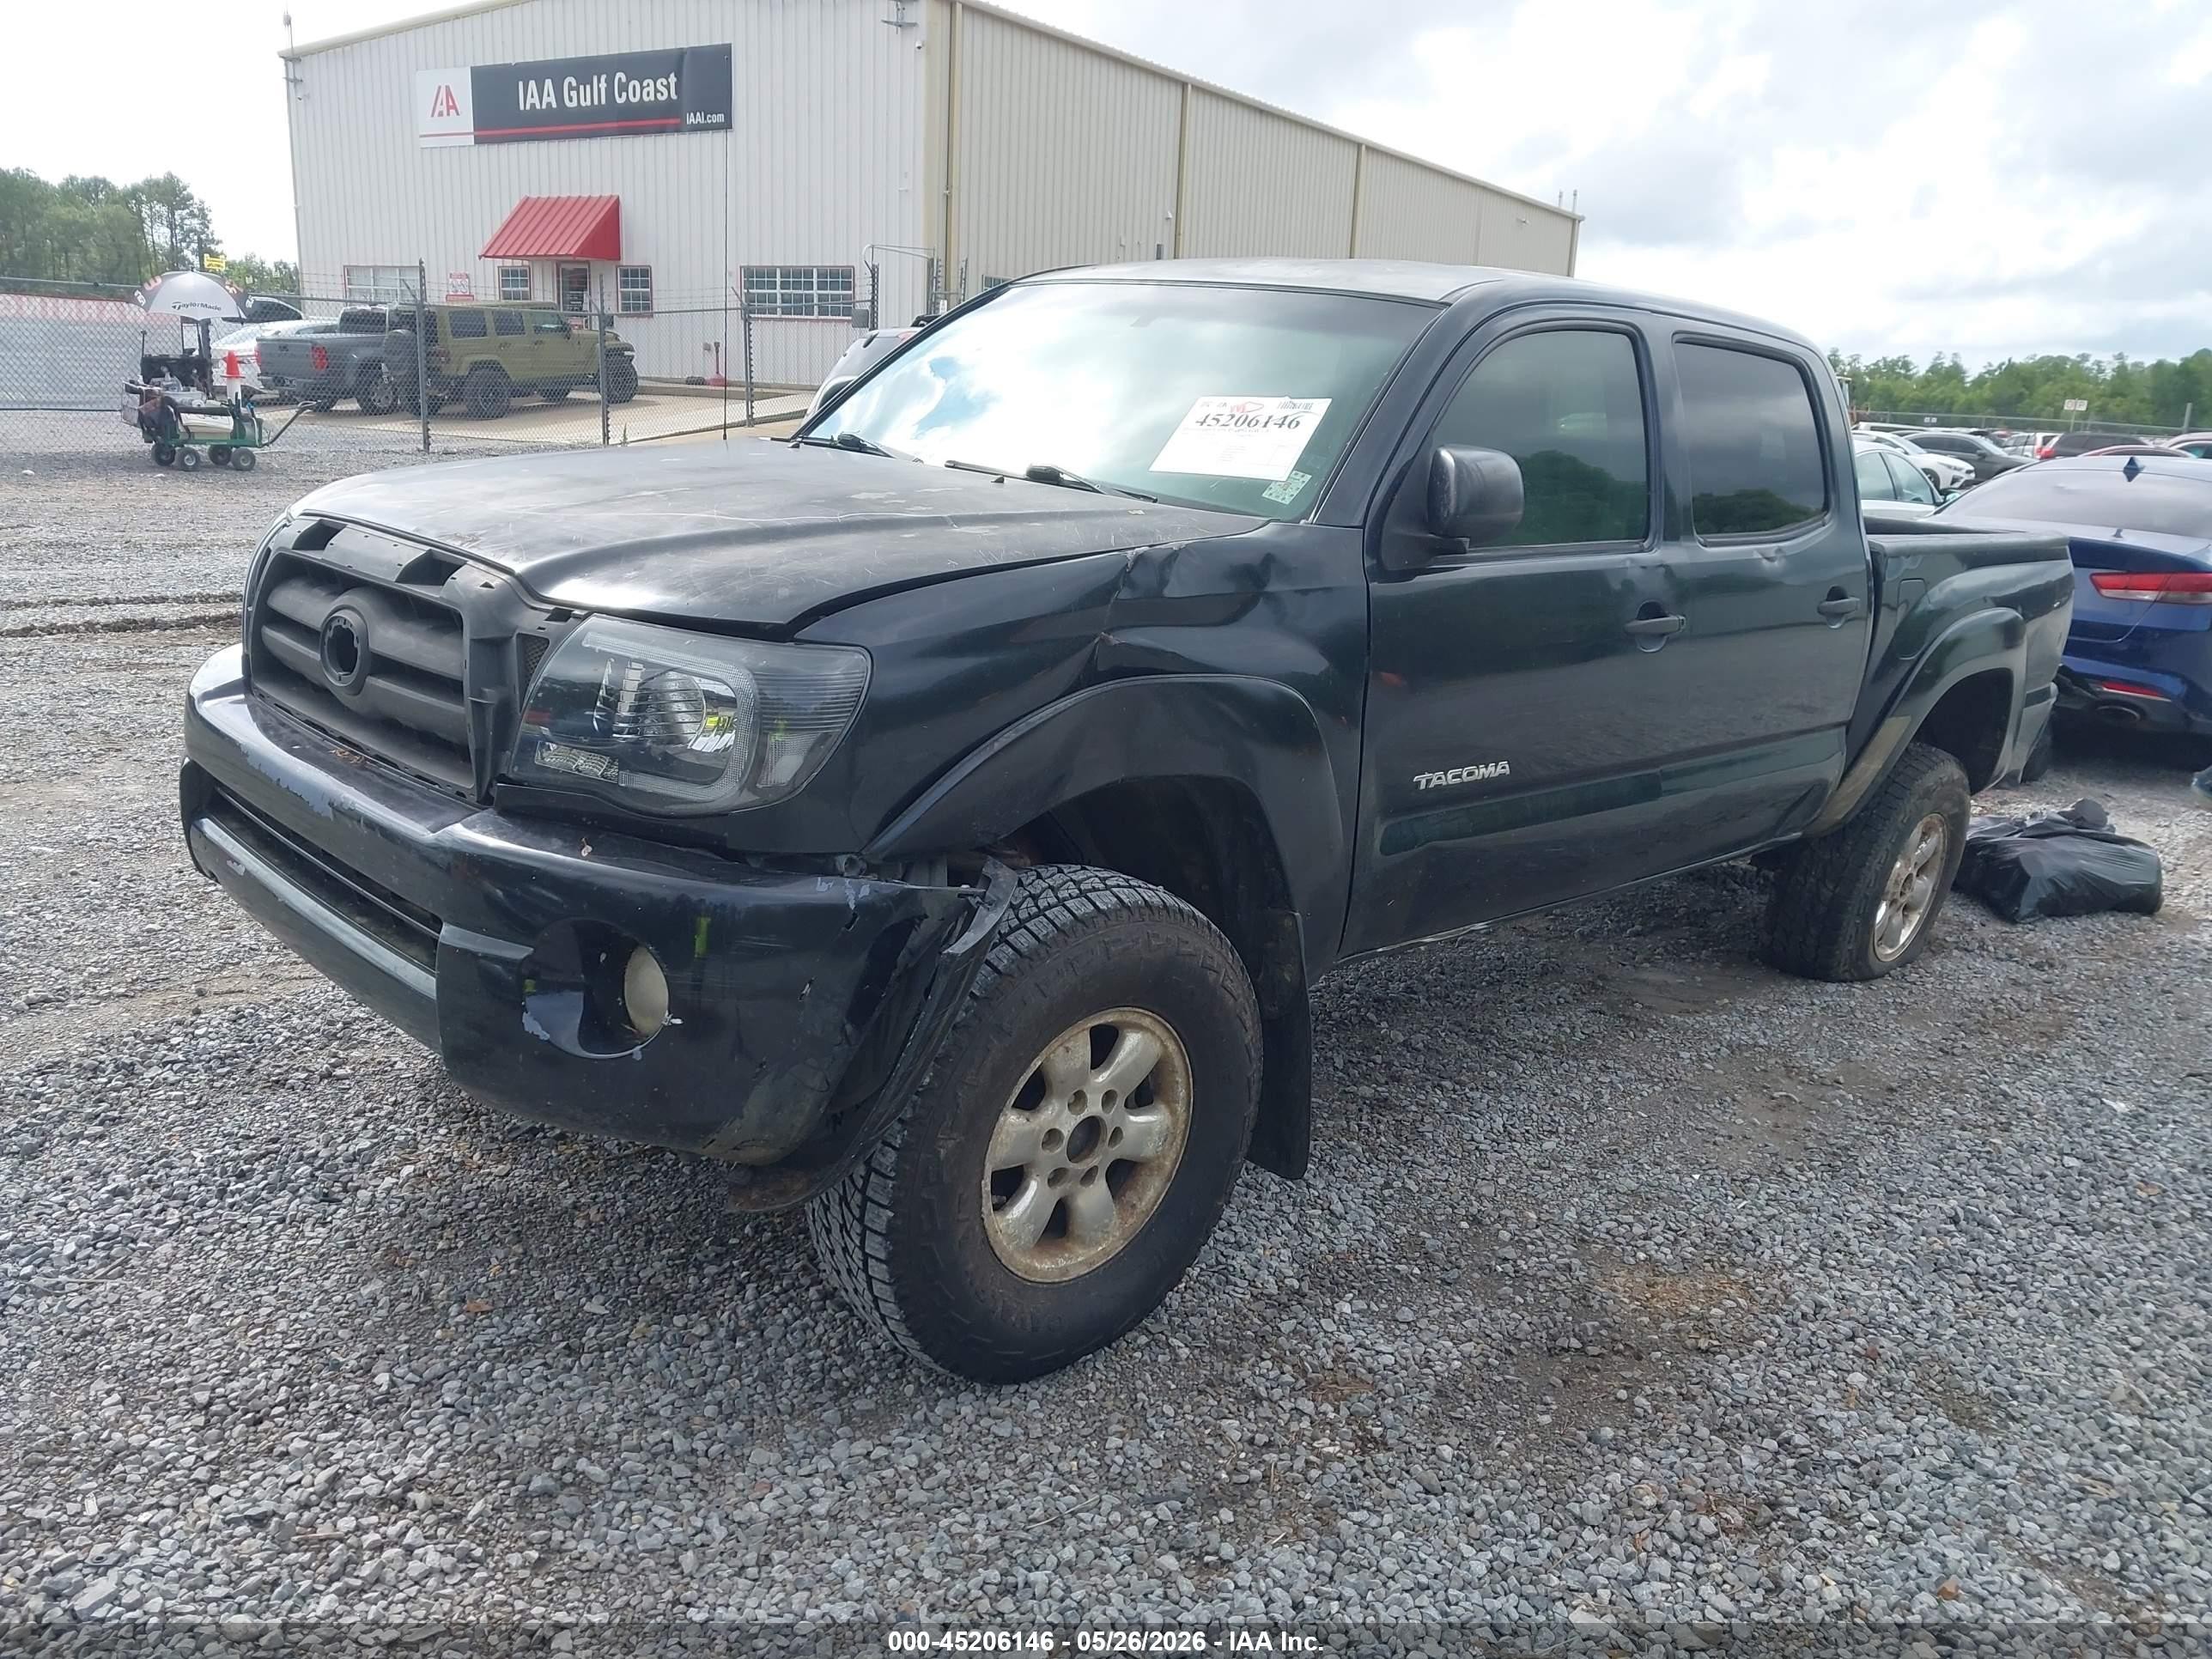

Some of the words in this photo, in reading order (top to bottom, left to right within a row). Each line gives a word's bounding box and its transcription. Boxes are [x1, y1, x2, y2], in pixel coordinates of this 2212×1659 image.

[518, 78, 557, 111] IAA
[562, 73, 607, 108] Gulf
[614, 71, 678, 104] Coast
[1195, 413, 1302, 429] 45206146
[1413, 761, 1510, 790] TACOMA
